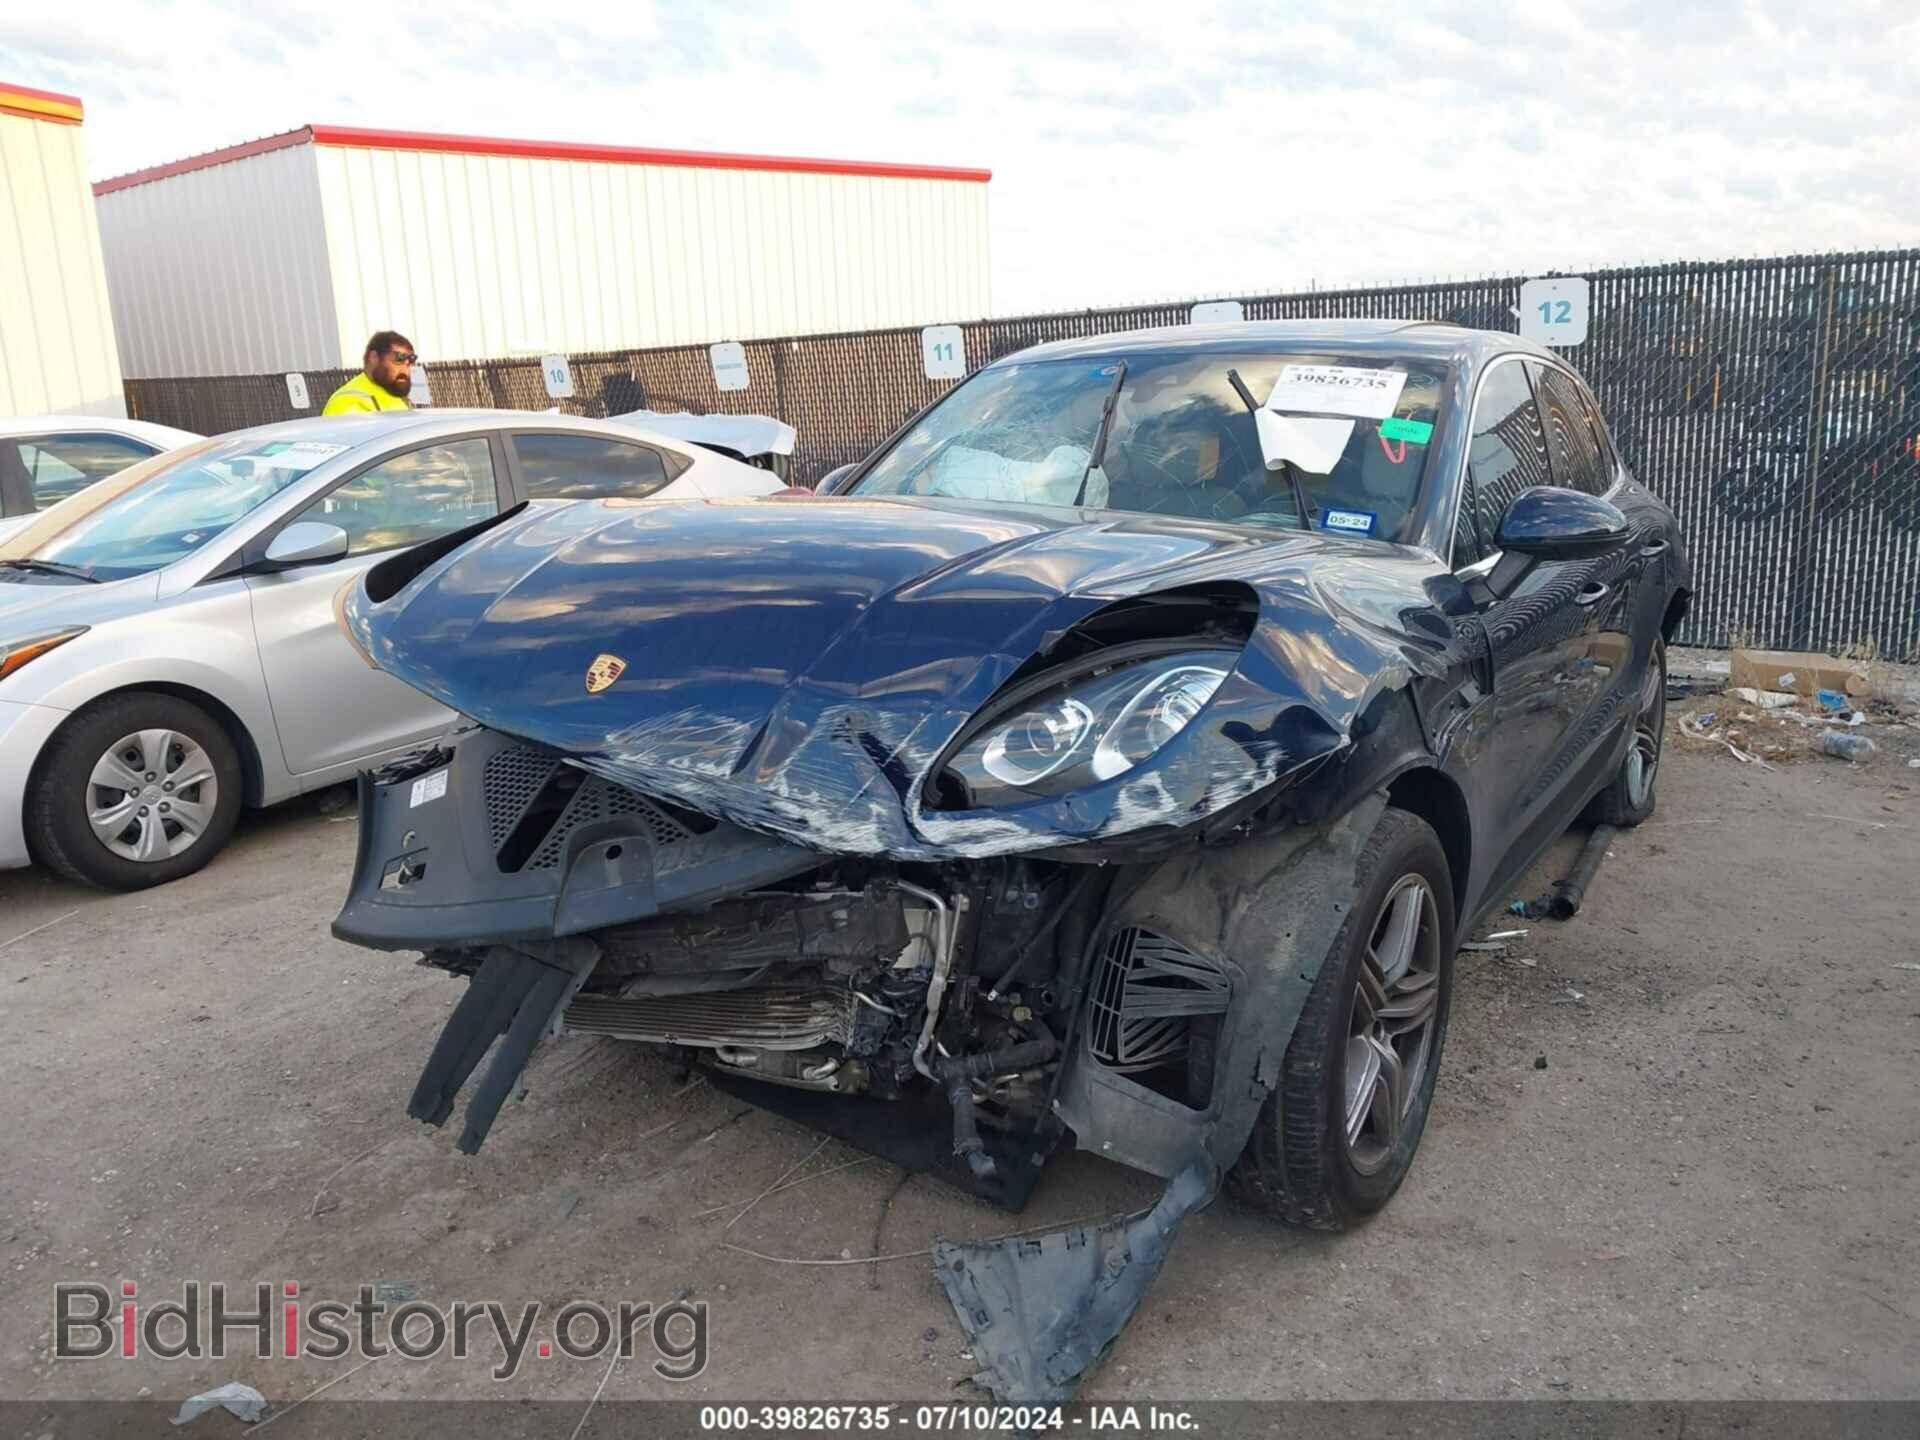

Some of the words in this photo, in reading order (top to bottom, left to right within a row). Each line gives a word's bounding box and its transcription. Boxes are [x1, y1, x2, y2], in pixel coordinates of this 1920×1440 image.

[1537, 300, 1571, 324] 12
[933, 343, 953, 361] 11
[549, 369, 565, 384] 10
[1290, 373, 1388, 389] 39826735
